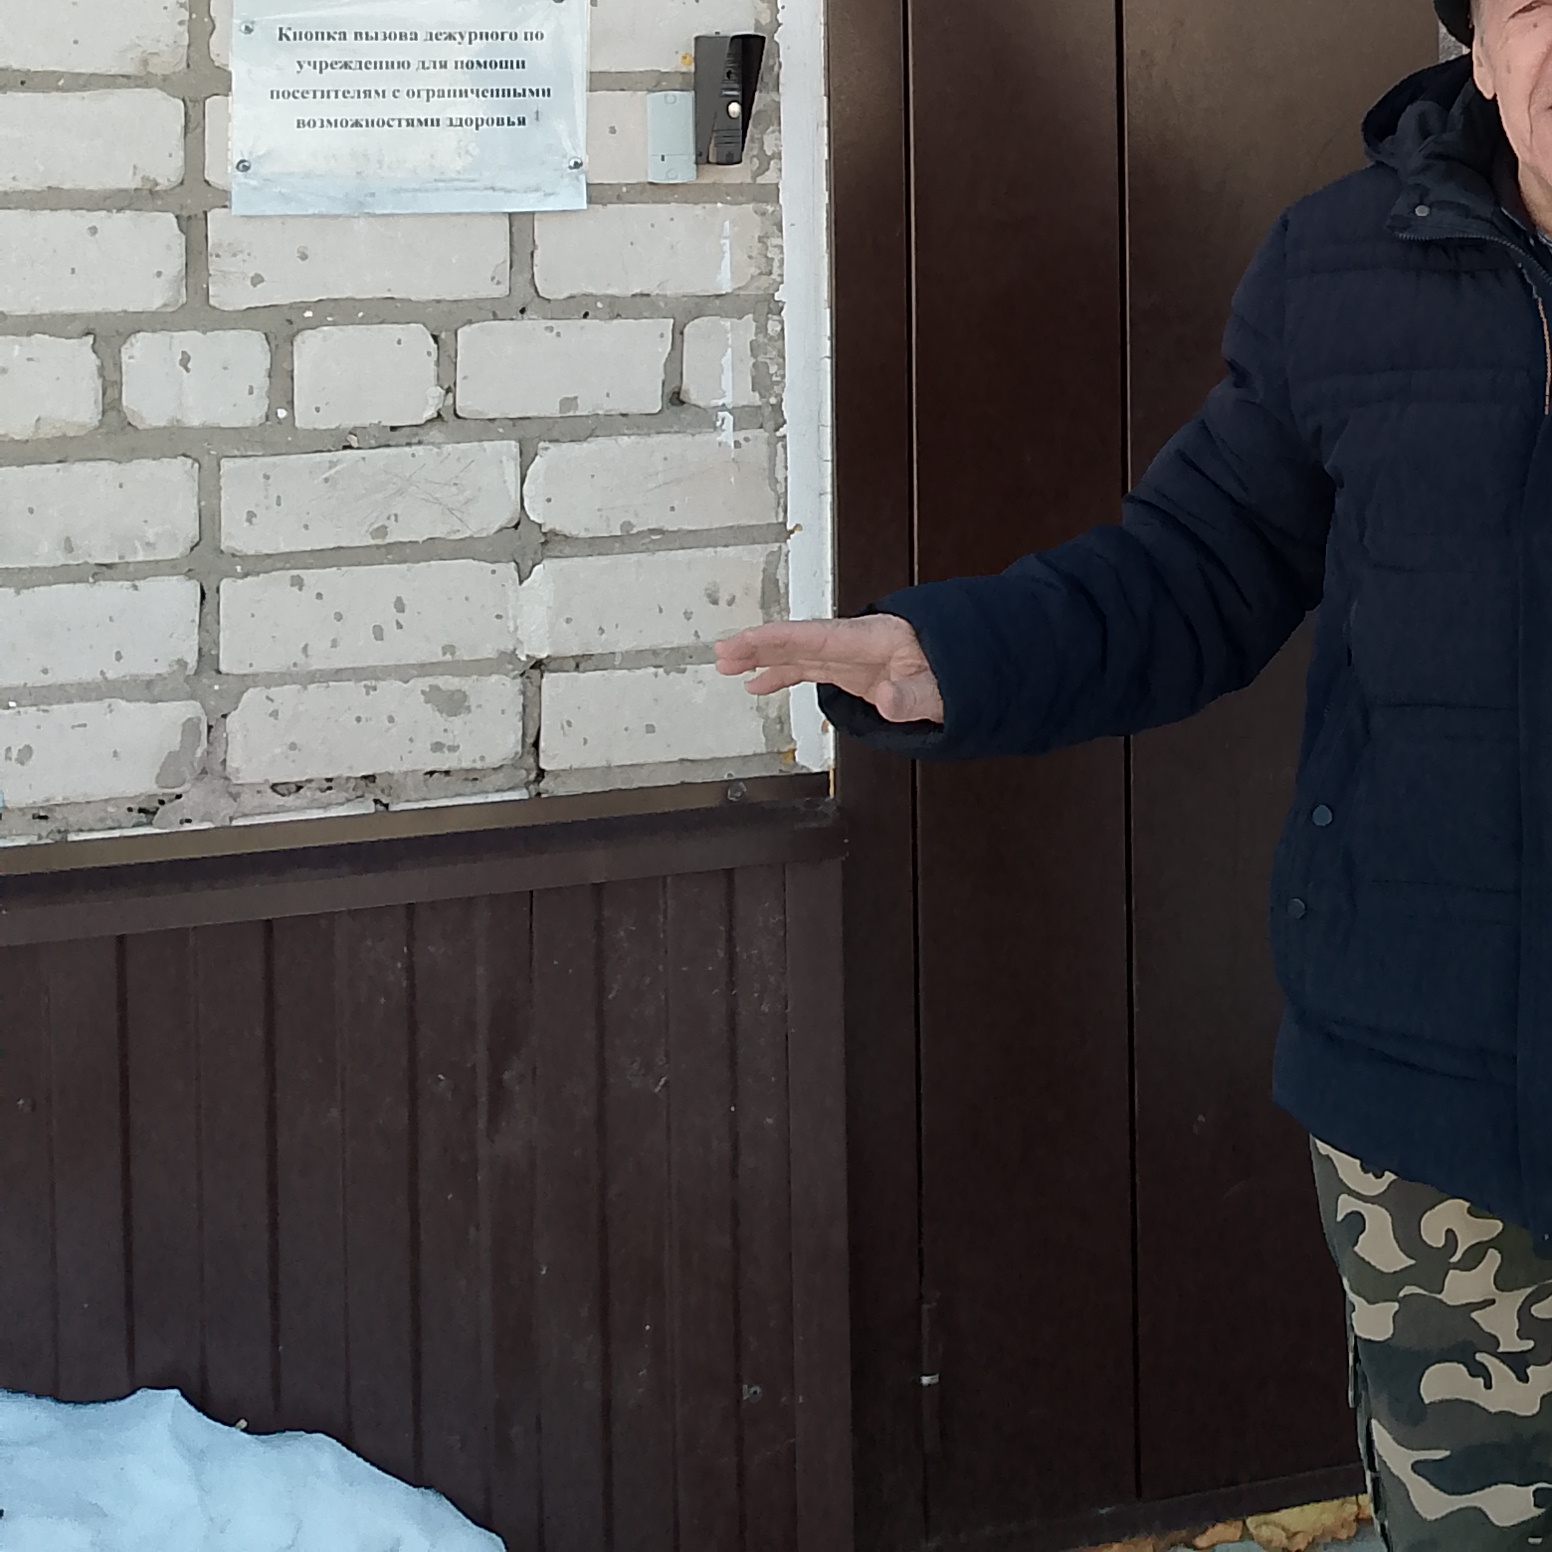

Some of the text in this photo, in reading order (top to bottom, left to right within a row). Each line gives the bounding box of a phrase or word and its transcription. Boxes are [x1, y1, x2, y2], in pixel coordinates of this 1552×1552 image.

[278, 26, 545, 45] Кнопка вызова дежурного по
[296, 59, 526, 74] учреждению для помощи
[270, 88, 551, 103] посетителям с ограниченными
[296, 116, 526, 131] возможностями здоровья
